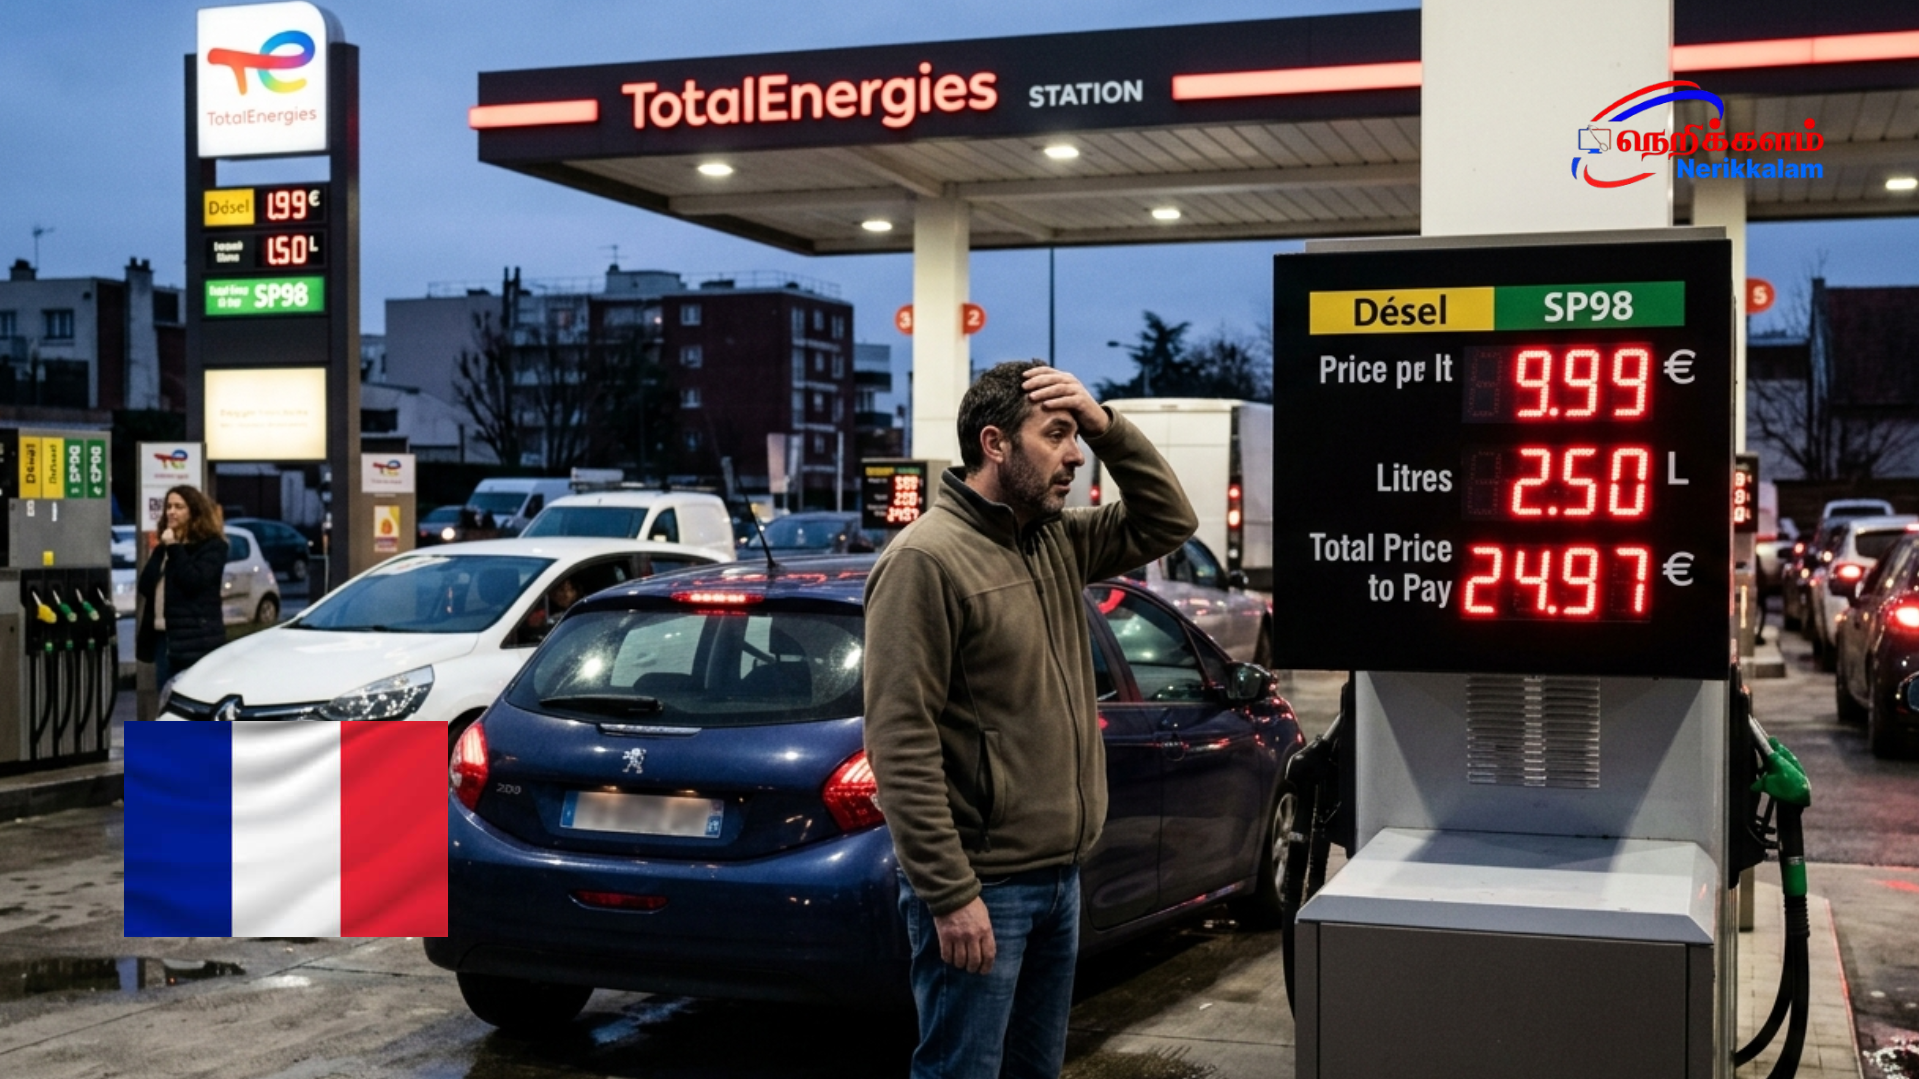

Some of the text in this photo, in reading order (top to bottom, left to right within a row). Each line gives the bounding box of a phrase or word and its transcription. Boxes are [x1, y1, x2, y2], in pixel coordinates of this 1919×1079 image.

[622, 62, 1144, 130] TotalEnergies STATION
[207, 107, 317, 126] TotalEnergies
[253, 281, 309, 309] SP98
[1353, 290, 1635, 327] Désel SP98
[967, 309, 981, 327] 2
[1319, 354, 1387, 385] Price
[1515, 347, 1650, 419] 9.99
[1663, 349, 1697, 385] €
[1376, 447, 1689, 517] Litres 2.50 L
[1310, 533, 1696, 616] Total Price 24.97 €
[1368, 574, 1453, 609] to Pay
